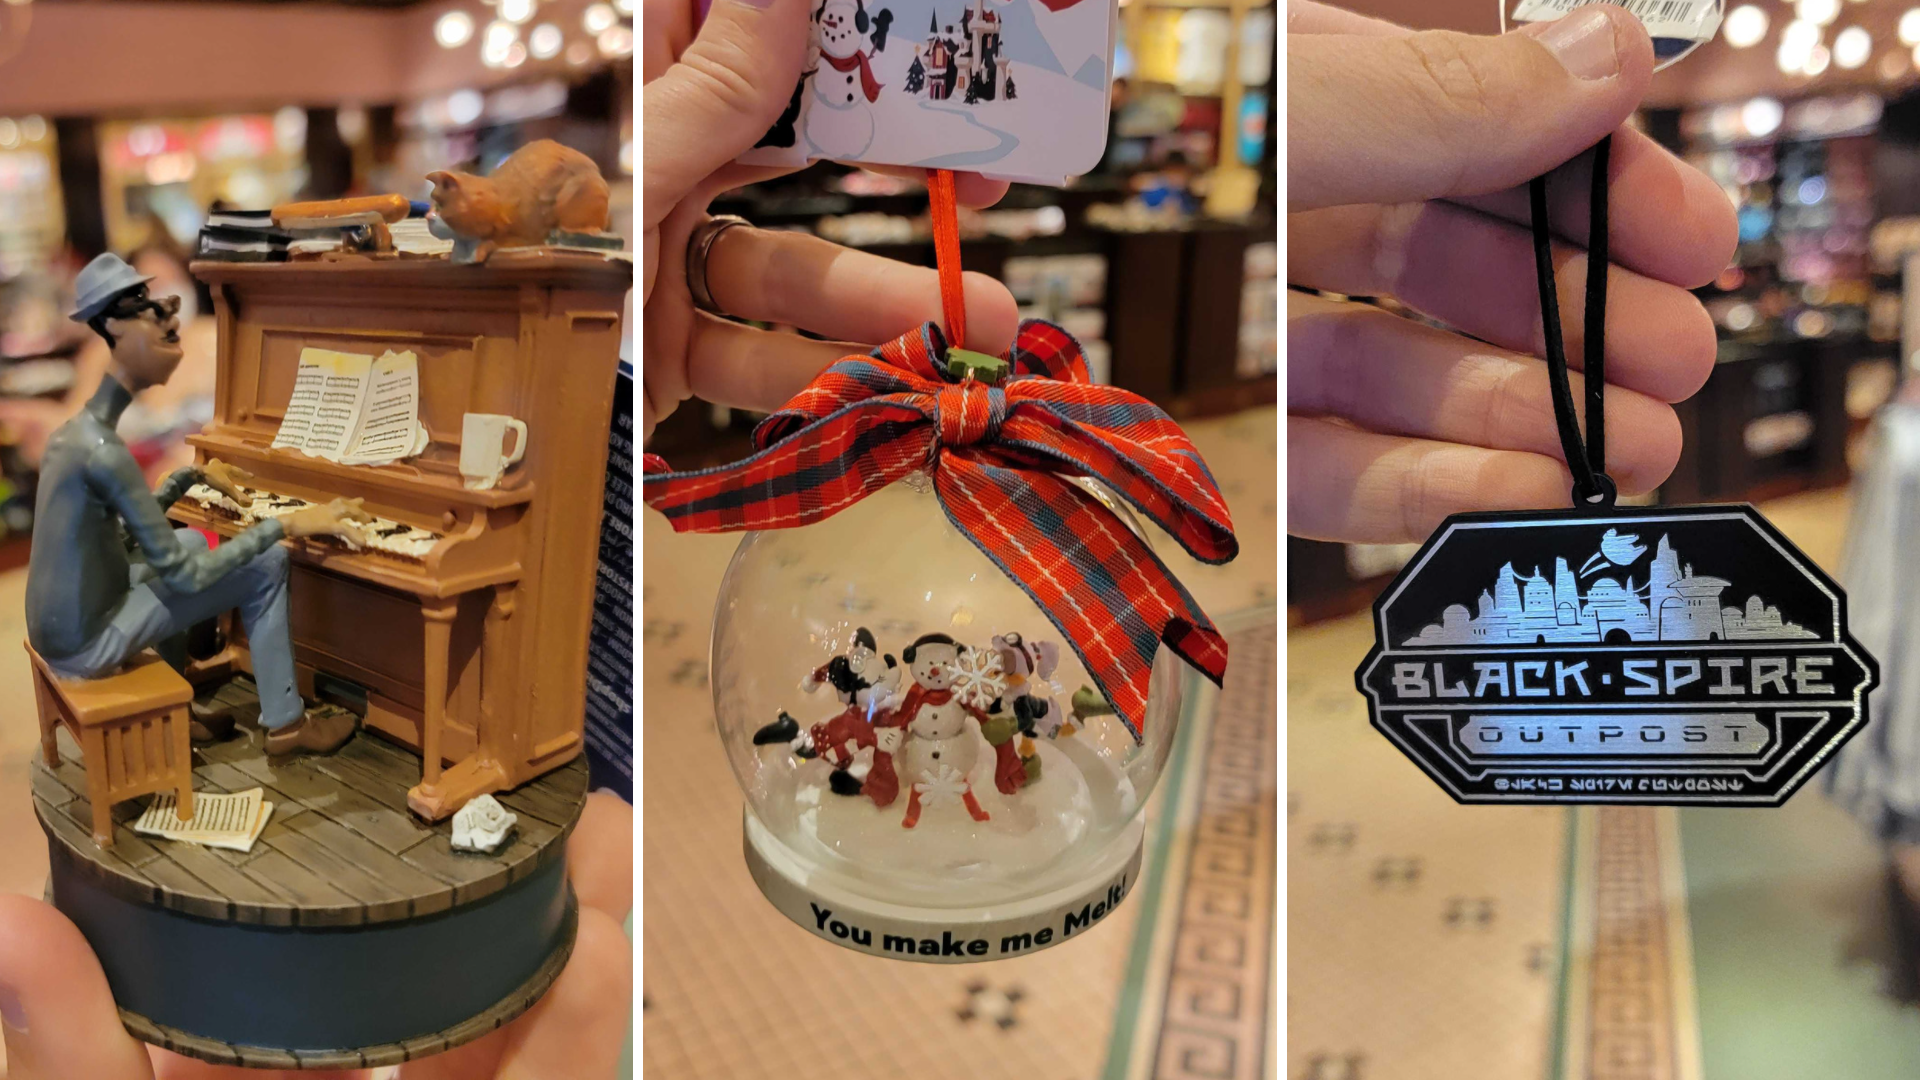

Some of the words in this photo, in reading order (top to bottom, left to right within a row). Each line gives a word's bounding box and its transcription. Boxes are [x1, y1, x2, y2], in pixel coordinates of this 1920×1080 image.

[1391, 660, 1593, 699] BLACK
[1622, 656, 1837, 697] SPIRE
[1477, 724, 1749, 744] OUTPOST
[809, 901, 872, 947] You
[882, 931, 989, 957] make
[1000, 926, 1054, 953] me
[1062, 874, 1128, 937] Melt!
